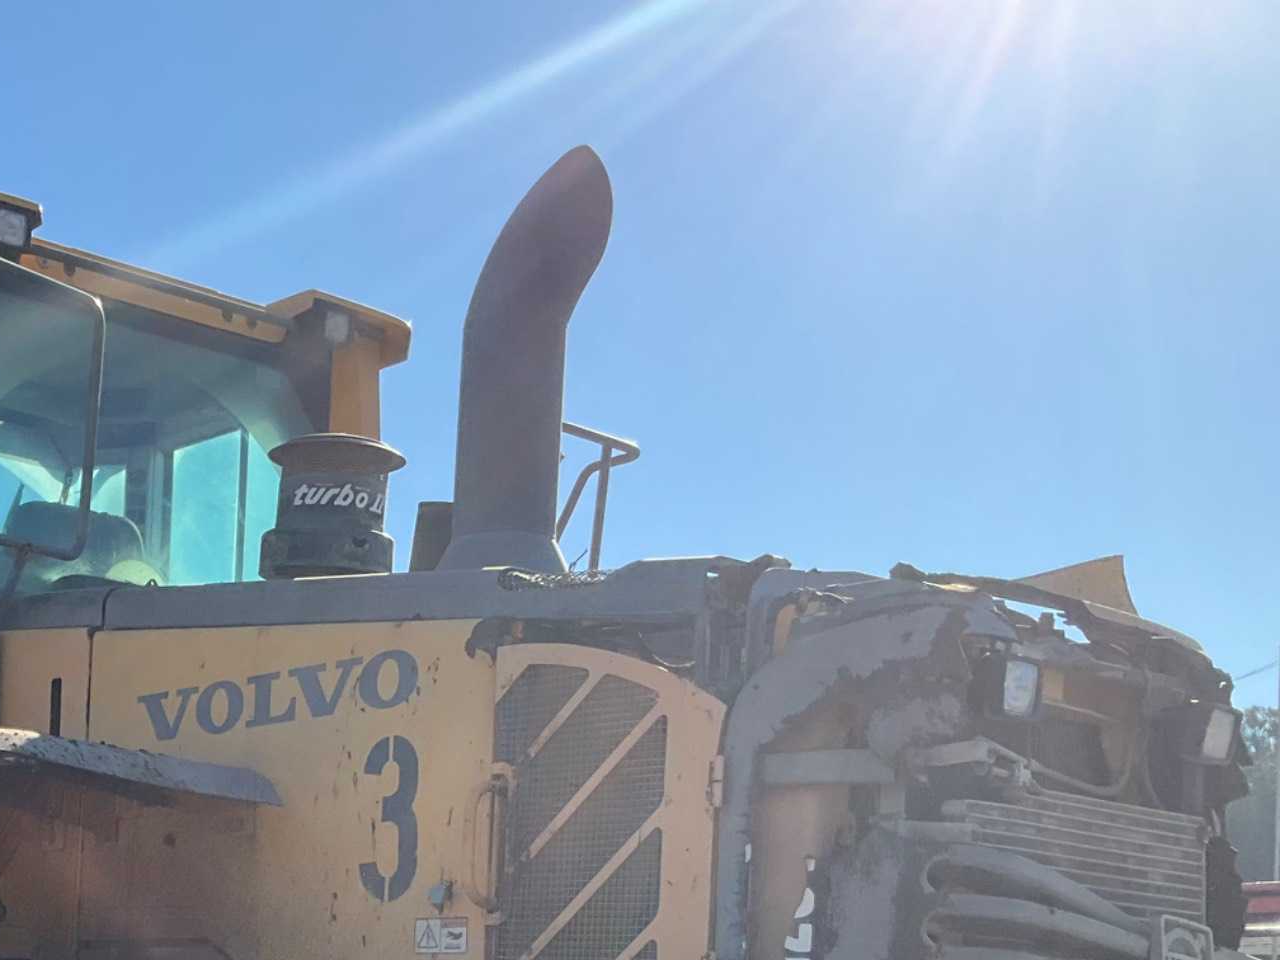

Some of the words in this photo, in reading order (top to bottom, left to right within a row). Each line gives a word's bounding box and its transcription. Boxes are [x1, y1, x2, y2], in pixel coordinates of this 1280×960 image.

[293, 483, 369, 508] turbo
[137, 649, 419, 741] VOLVO
[358, 735, 419, 902] 3
